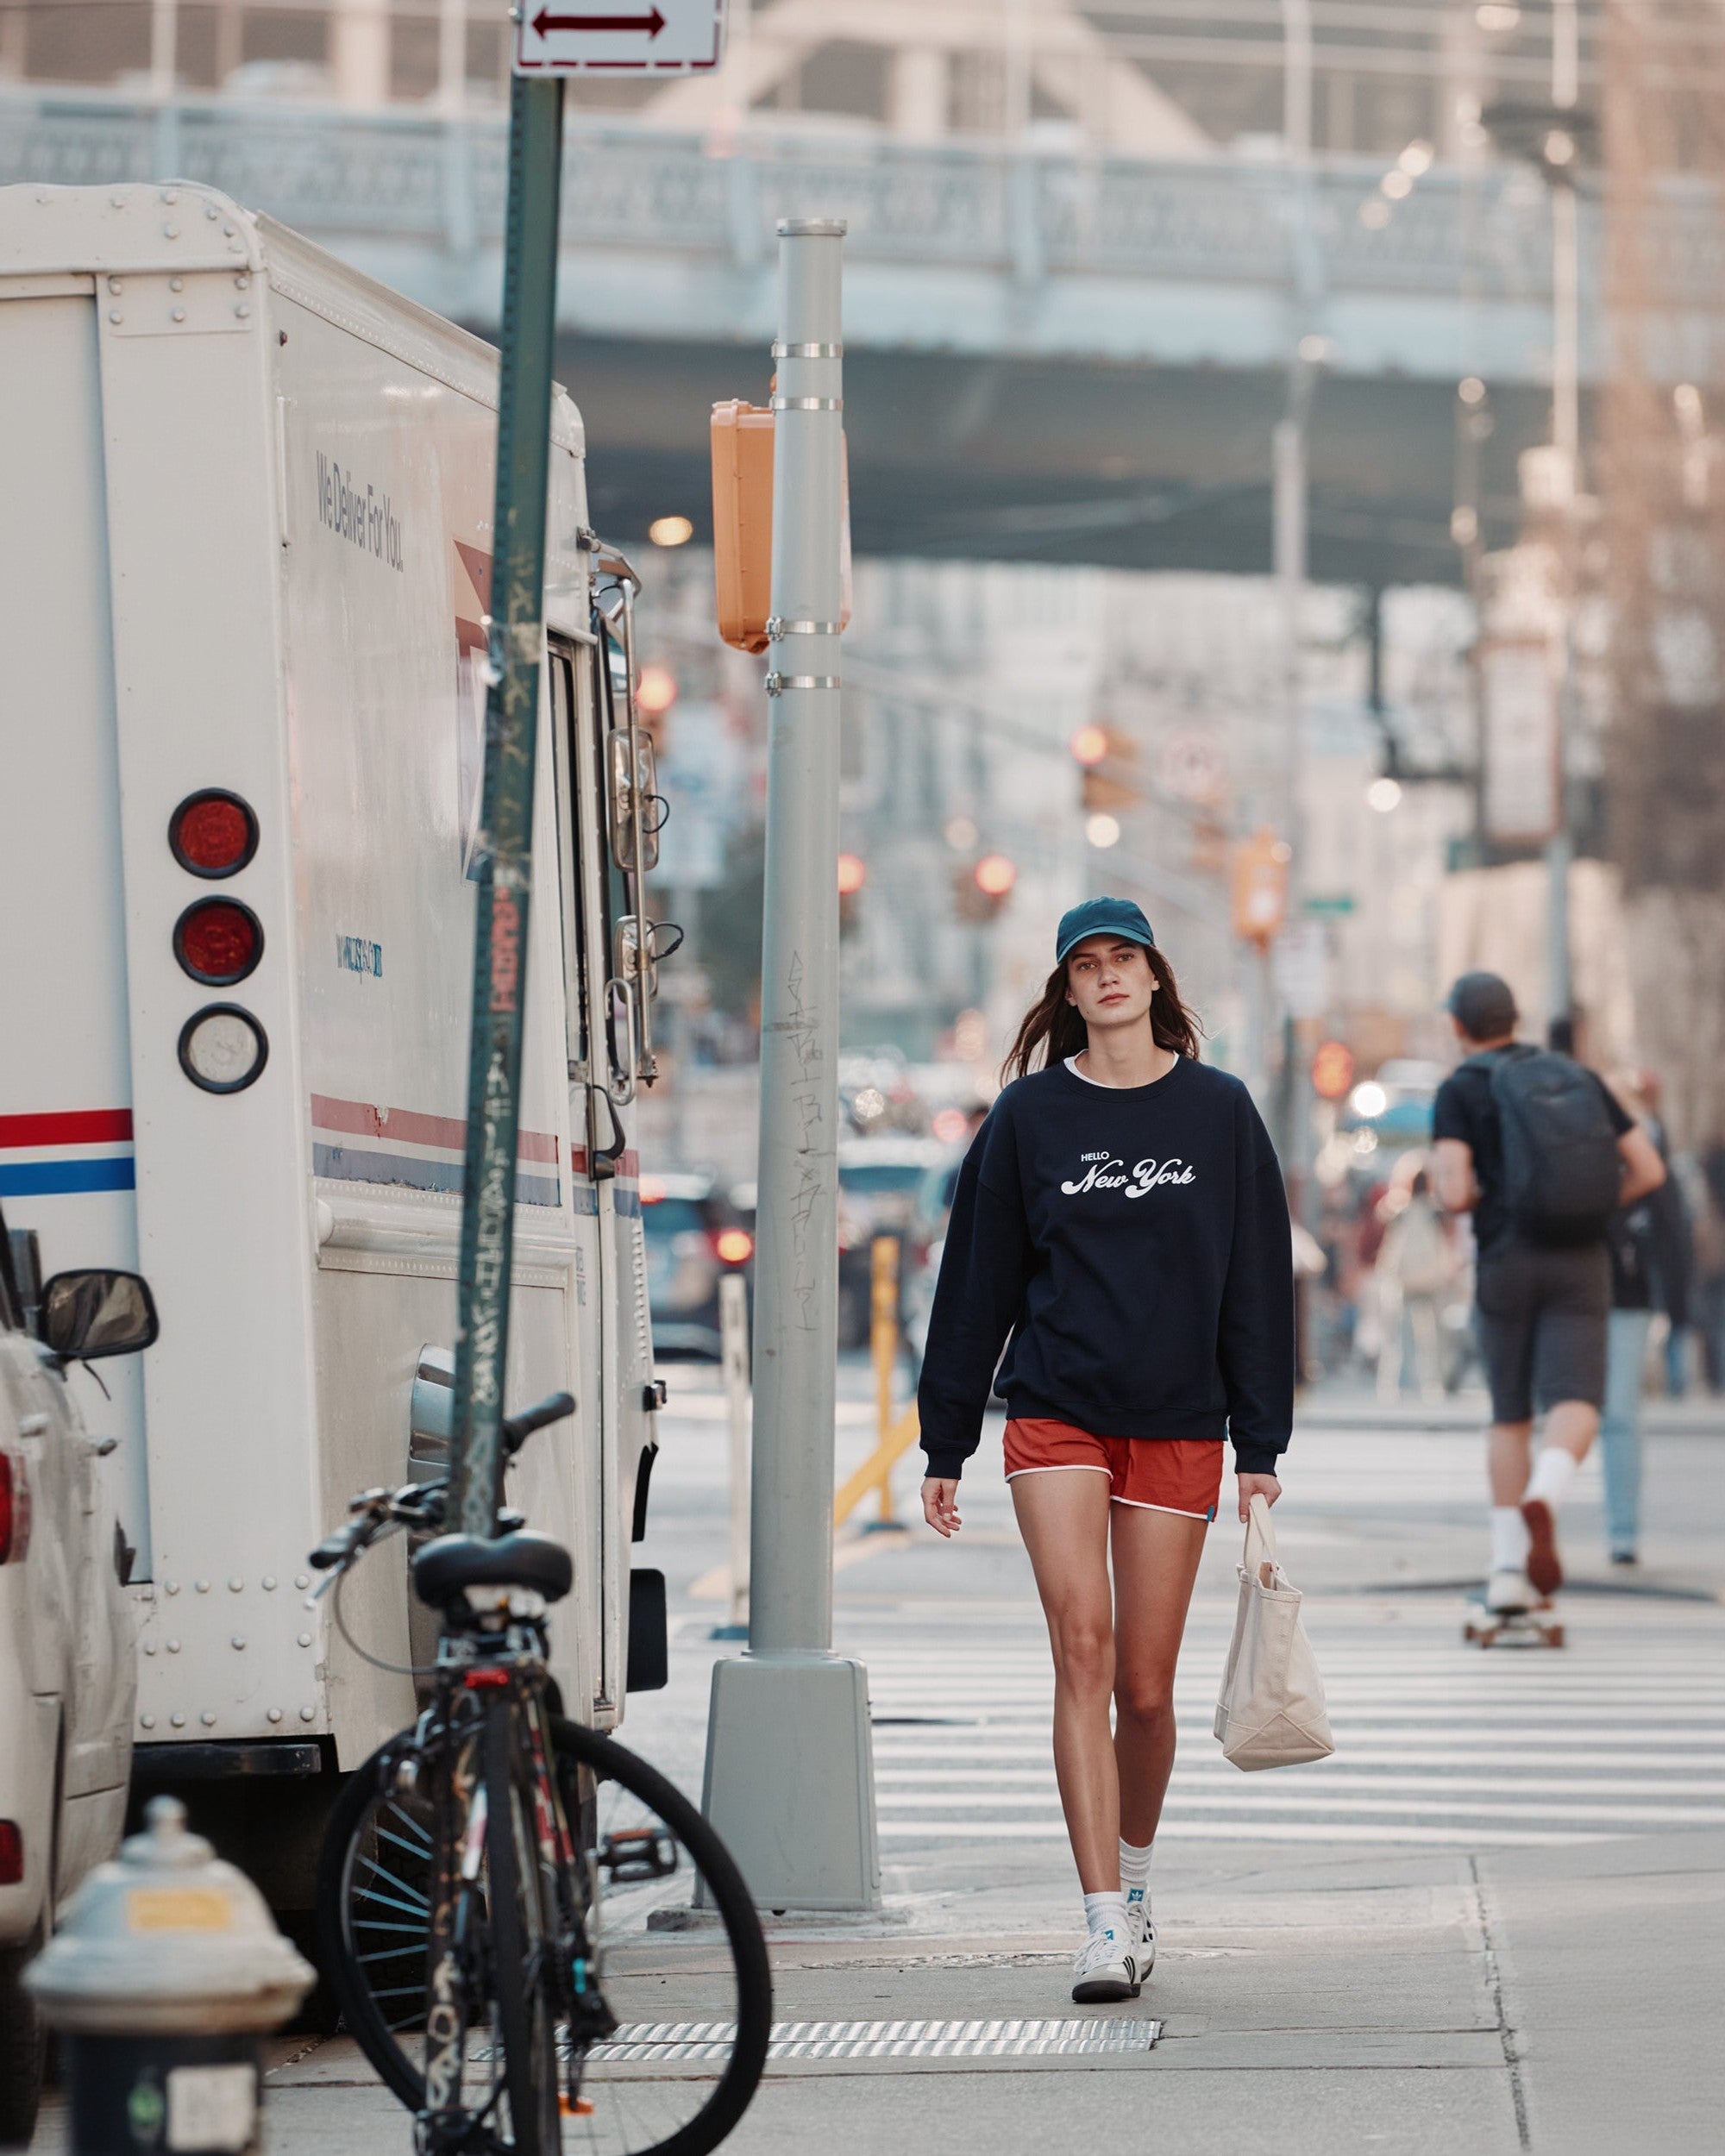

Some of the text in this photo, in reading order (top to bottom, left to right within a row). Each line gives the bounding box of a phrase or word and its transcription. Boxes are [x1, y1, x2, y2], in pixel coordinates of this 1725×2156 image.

[317, 450, 404, 573] We Deliver For You.
[1081, 1151, 1110, 1162] HELLO
[1061, 1158, 1196, 1199] New York
